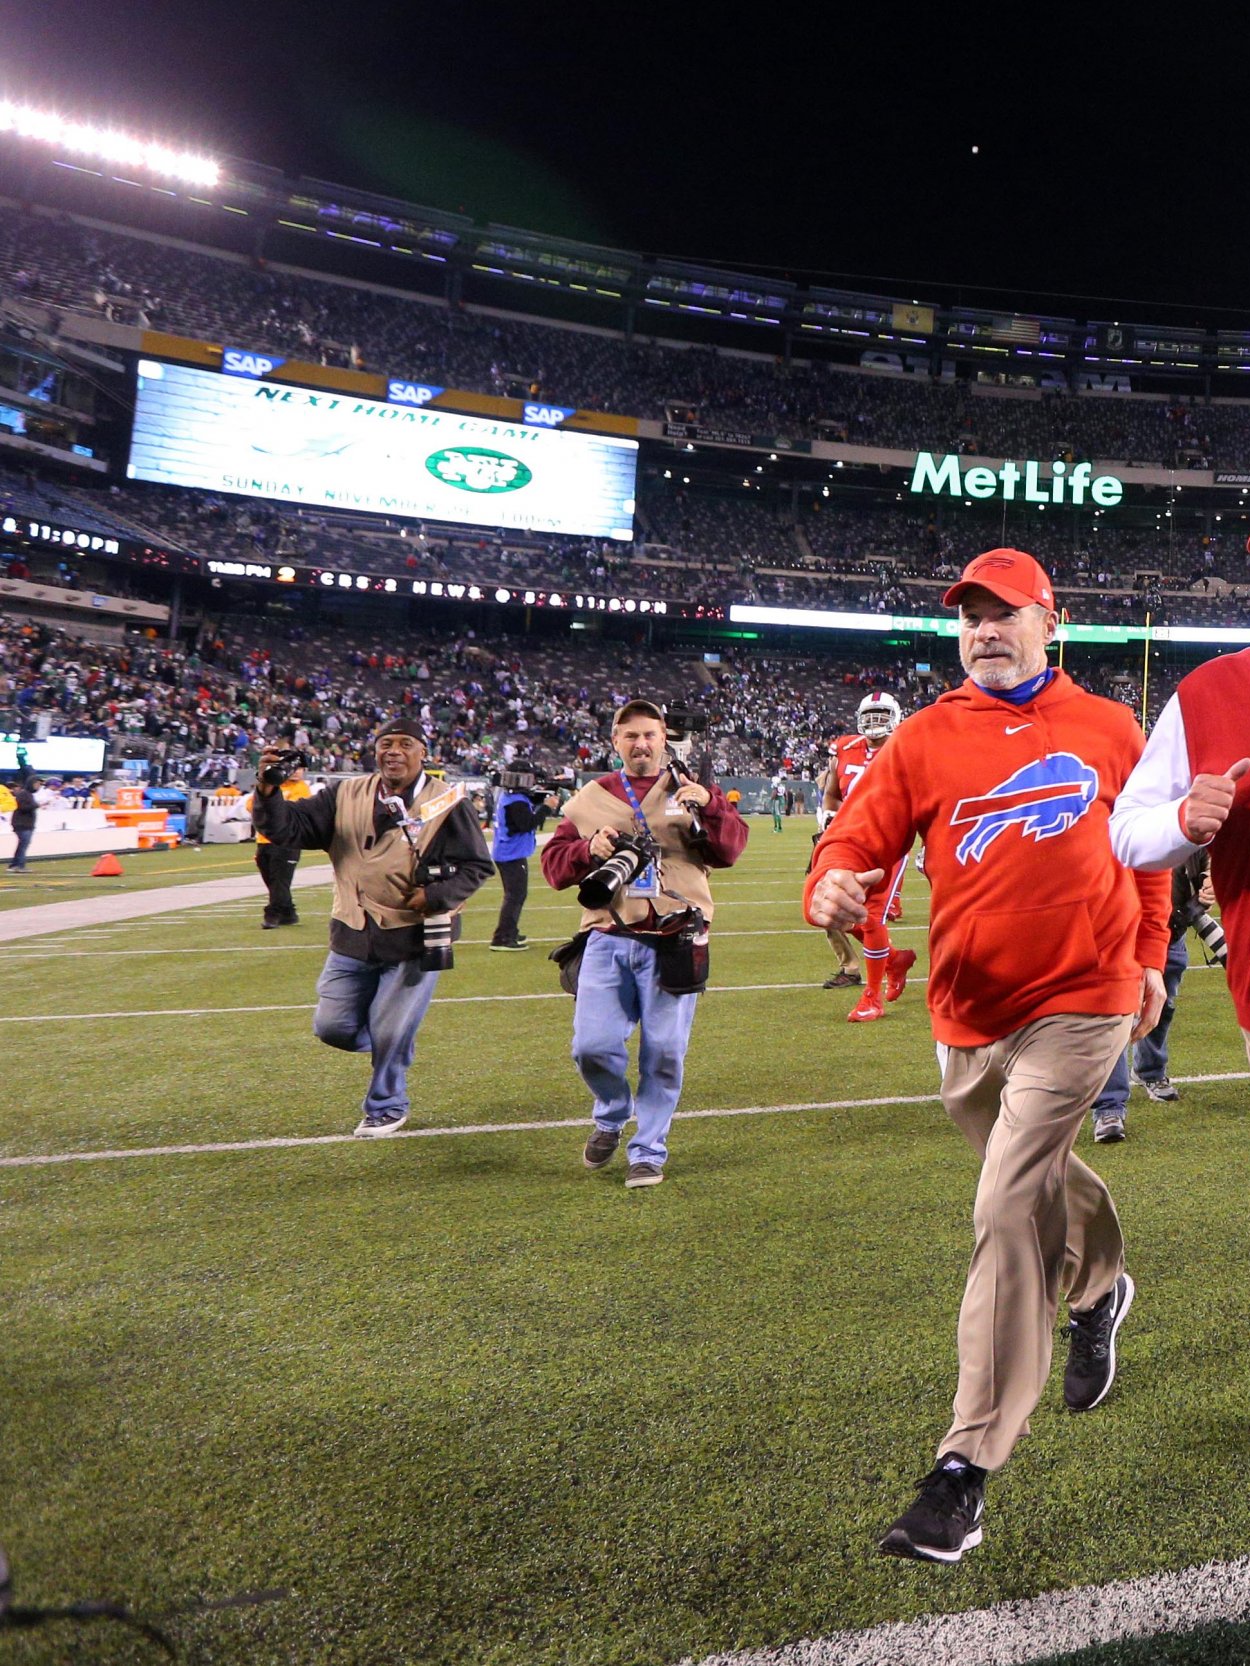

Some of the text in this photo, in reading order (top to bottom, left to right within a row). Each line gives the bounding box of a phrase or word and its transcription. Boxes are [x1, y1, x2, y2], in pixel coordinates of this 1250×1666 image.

[224, 352, 273, 377] SAP
[253, 385, 341, 410] NEXT
[388, 382, 432, 405] SAP
[524, 405, 565, 425] SAP
[910, 451, 1123, 507] MetLife
[28, 522, 119, 555] 11:00PM
[320, 572, 369, 592] CBS
[384, 578, 397, 592] 2
[412, 580, 481, 600] NEWS
[575, 594, 667, 615] 11:00PM
